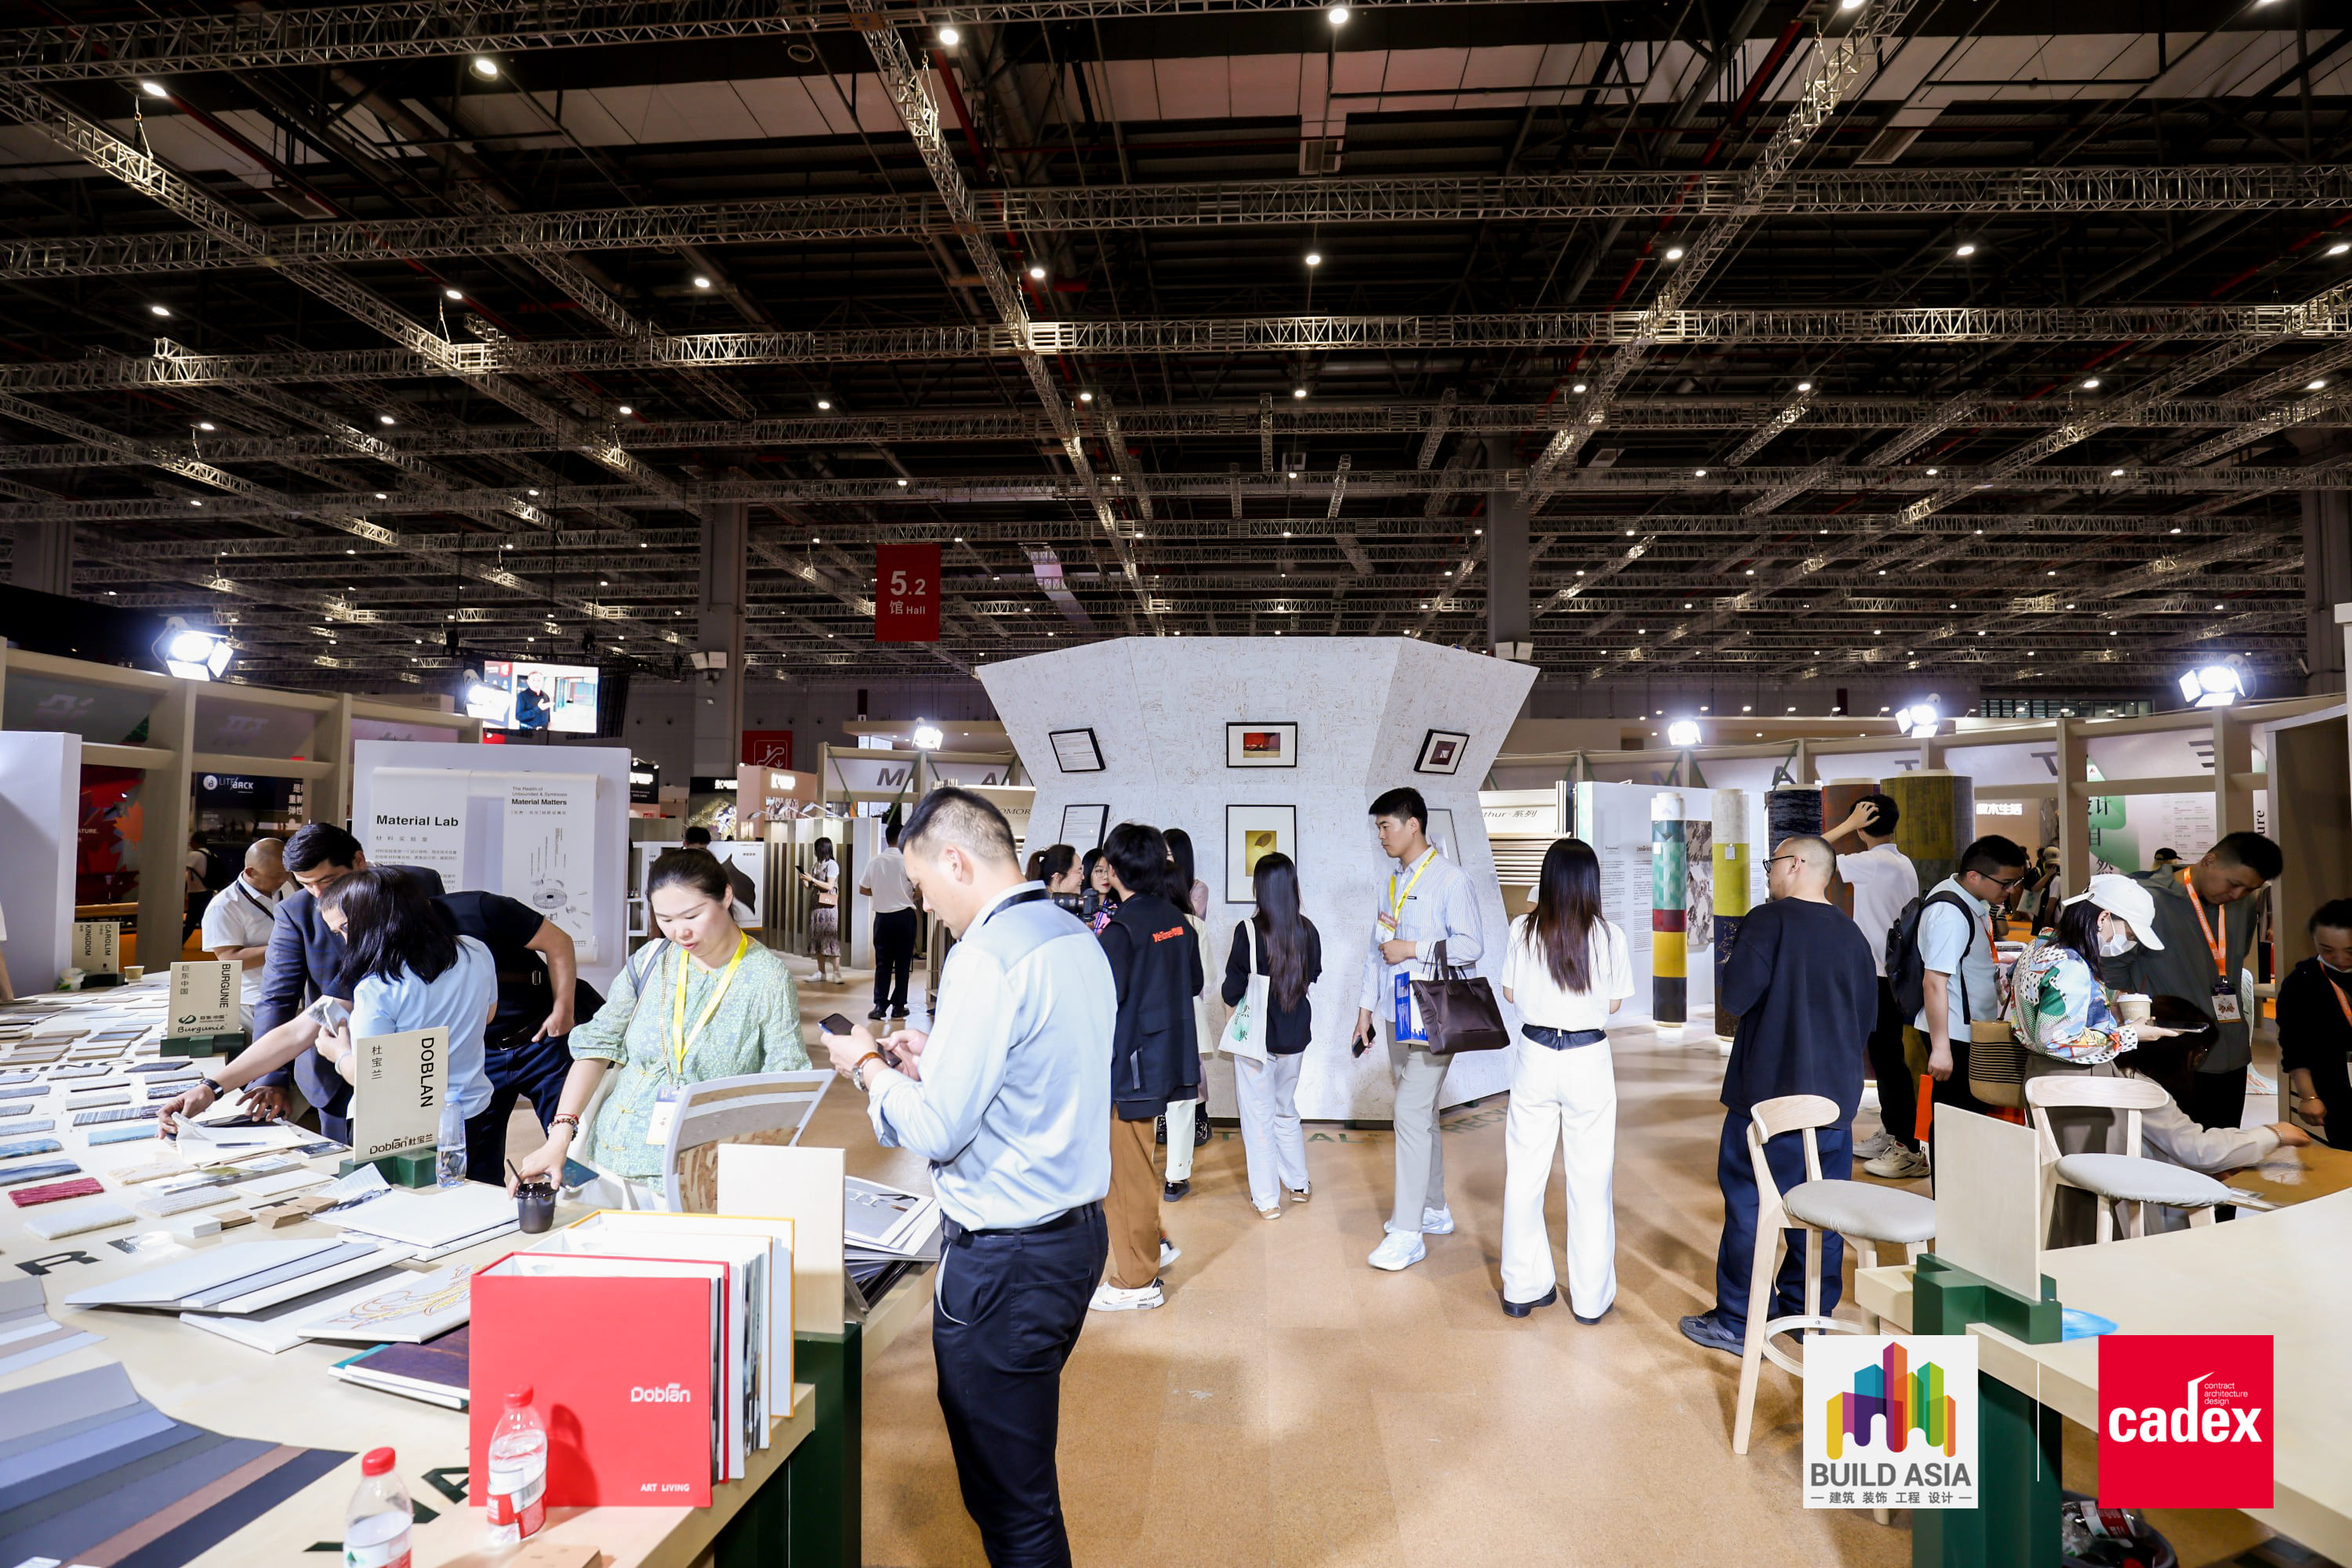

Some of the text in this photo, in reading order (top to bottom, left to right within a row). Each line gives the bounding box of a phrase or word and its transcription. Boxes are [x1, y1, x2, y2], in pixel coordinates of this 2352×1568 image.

[890, 570, 926, 596] 5.2
[889, 600, 904, 615] 馆
[906, 605, 926, 615] Hall
[376, 815, 459, 826] Material Lab
[180, 965, 191, 995] 巨东中国
[219, 964, 231, 1009] BURGUNIE
[371, 1044, 383, 1080] 杜宝兰
[420, 1036, 435, 1108] DOBLAN
[408, 1134, 434, 1146] 杜宝兰
[641, 1483, 691, 1492] ART LIVING
